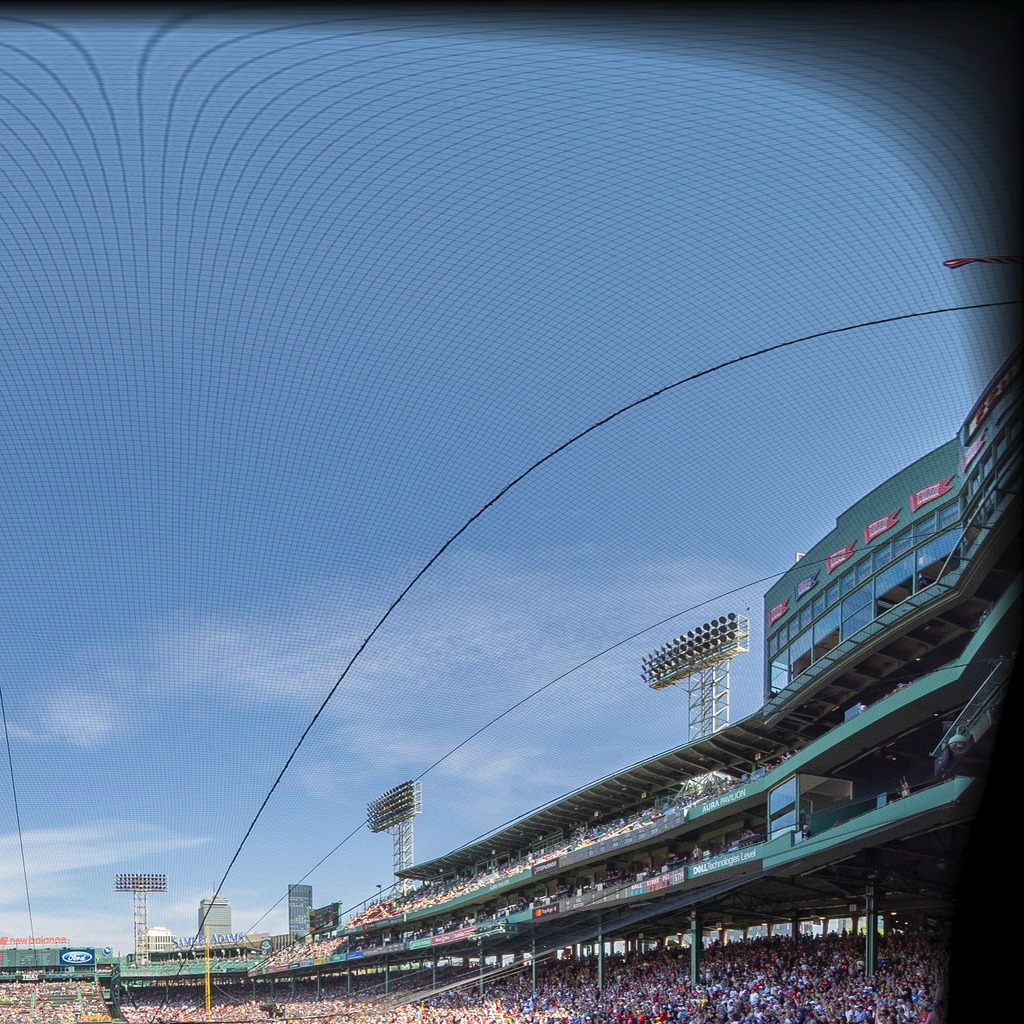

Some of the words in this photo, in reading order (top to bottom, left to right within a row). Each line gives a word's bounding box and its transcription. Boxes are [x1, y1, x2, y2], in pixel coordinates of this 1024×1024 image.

[720, 789, 746, 805] PAVILION
[707, 856, 740, 871] Technologies
[740, 850, 756, 861] Level
[10, 937, 27, 945] new
[28, 935, 67, 945] balance
[211, 932, 245, 944] ADAMS
[67, 953, 86, 962] Ford
